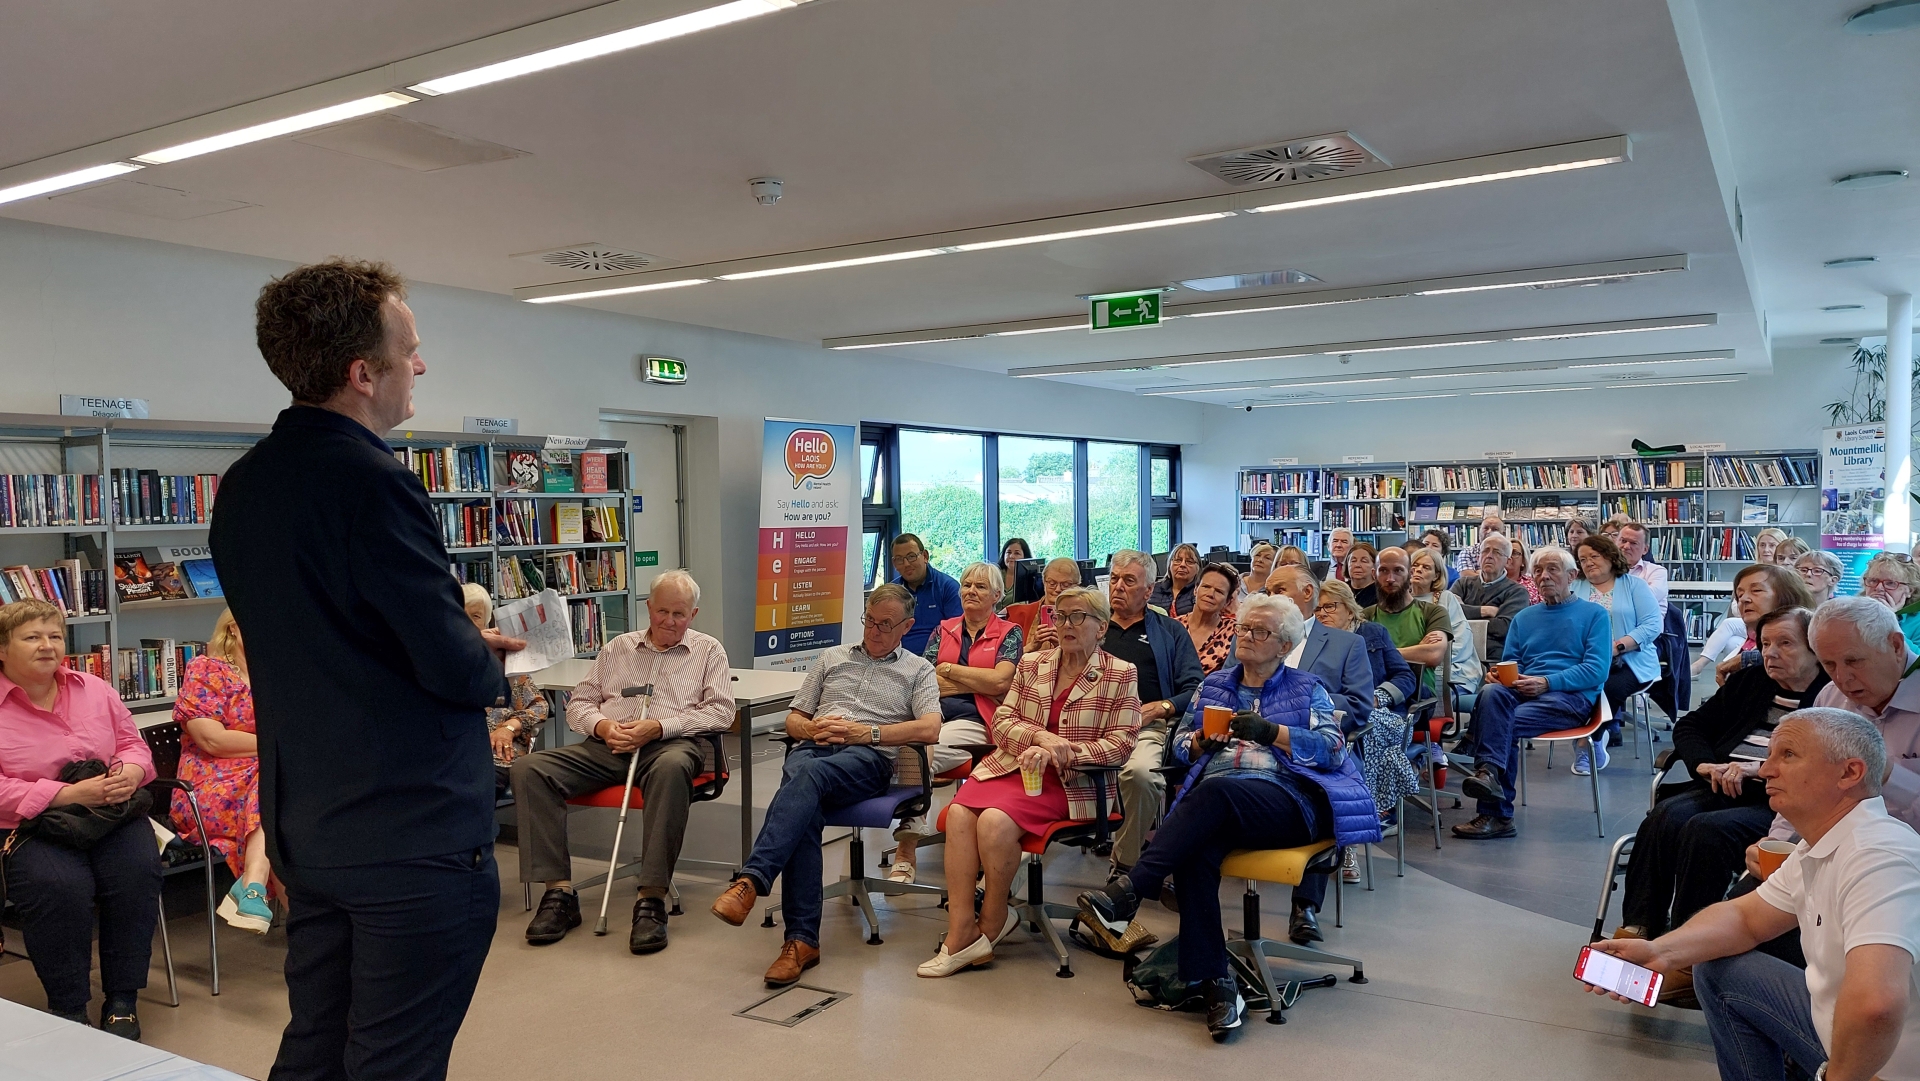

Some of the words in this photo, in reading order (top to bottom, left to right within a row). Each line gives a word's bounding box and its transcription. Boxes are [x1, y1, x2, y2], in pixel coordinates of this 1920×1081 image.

[80, 397, 133, 410] TEENAGE
[475, 418, 508, 427] TEENAGE
[547, 436, 563, 445] New
[564, 437, 588, 446] Books!
[795, 437, 828, 454] Hello
[801, 454, 820, 463] LAOIS
[1843, 456, 1874, 466] Library
[586, 466, 605, 474] HEART
[777, 499, 790, 511] Say
[791, 499, 810, 509] Hello
[811, 500, 824, 509] and
[825, 500, 839, 509] ask:
[784, 512, 801, 521] How
[814, 512, 831, 523] you?
[772, 531, 784, 549] H
[795, 531, 816, 539] HELLO
[772, 559, 782, 574] e
[794, 556, 817, 565] ENGAGE
[792, 581, 813, 589] LISTEN
[791, 604, 811, 612] LEARN
[790, 630, 815, 640] OPTIONS
[166, 657, 176, 689] OBLIVION
